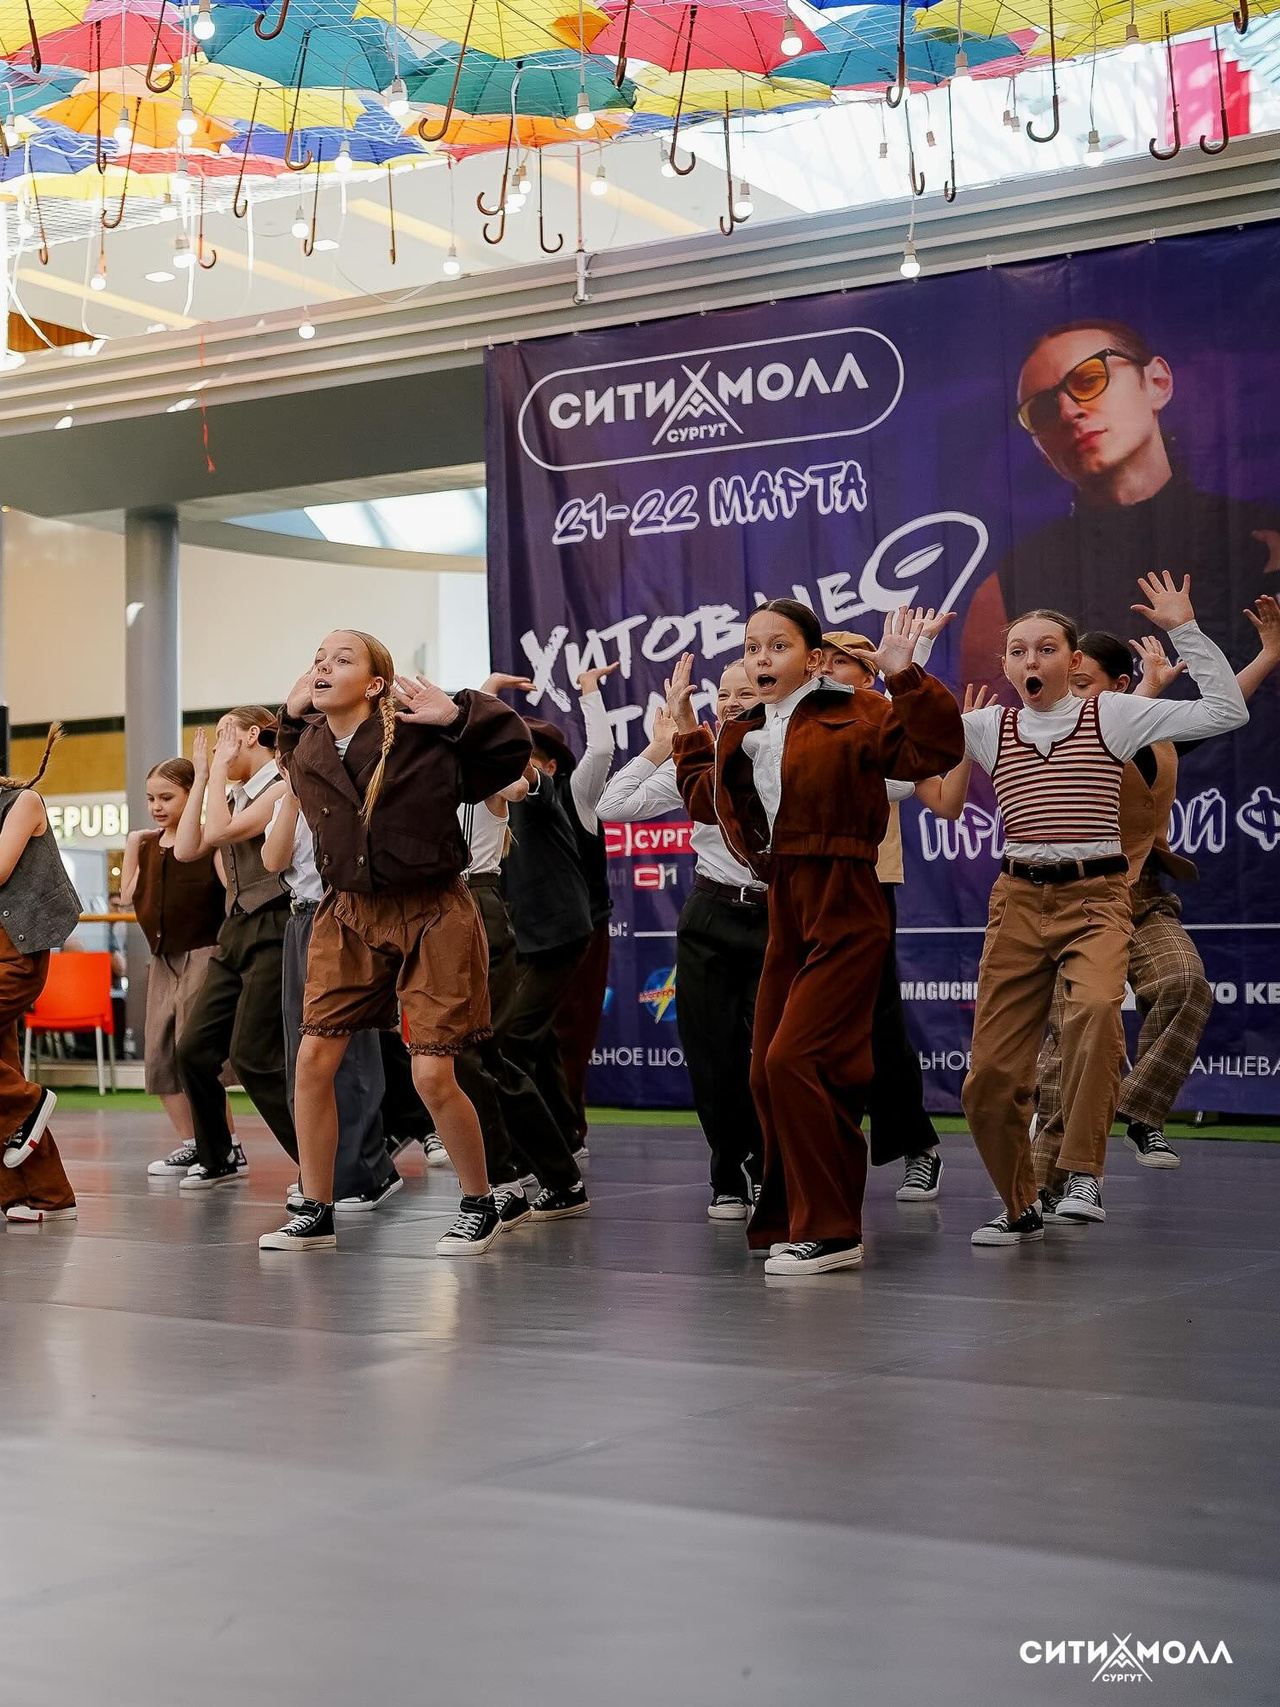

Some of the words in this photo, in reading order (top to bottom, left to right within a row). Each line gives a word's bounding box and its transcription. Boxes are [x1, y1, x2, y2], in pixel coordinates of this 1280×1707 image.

[548, 378, 675, 430] СИТИ
[718, 352, 869, 405] МОЛЛ
[666, 422, 728, 443] СУРГУТ
[552, 484, 700, 545] 21-22
[709, 460, 867, 526] МАРТА
[633, 827, 694, 849] СУРГ
[588, 1046, 644, 1066] ЬНОЕ
[647, 1047, 688, 1066] ШО
